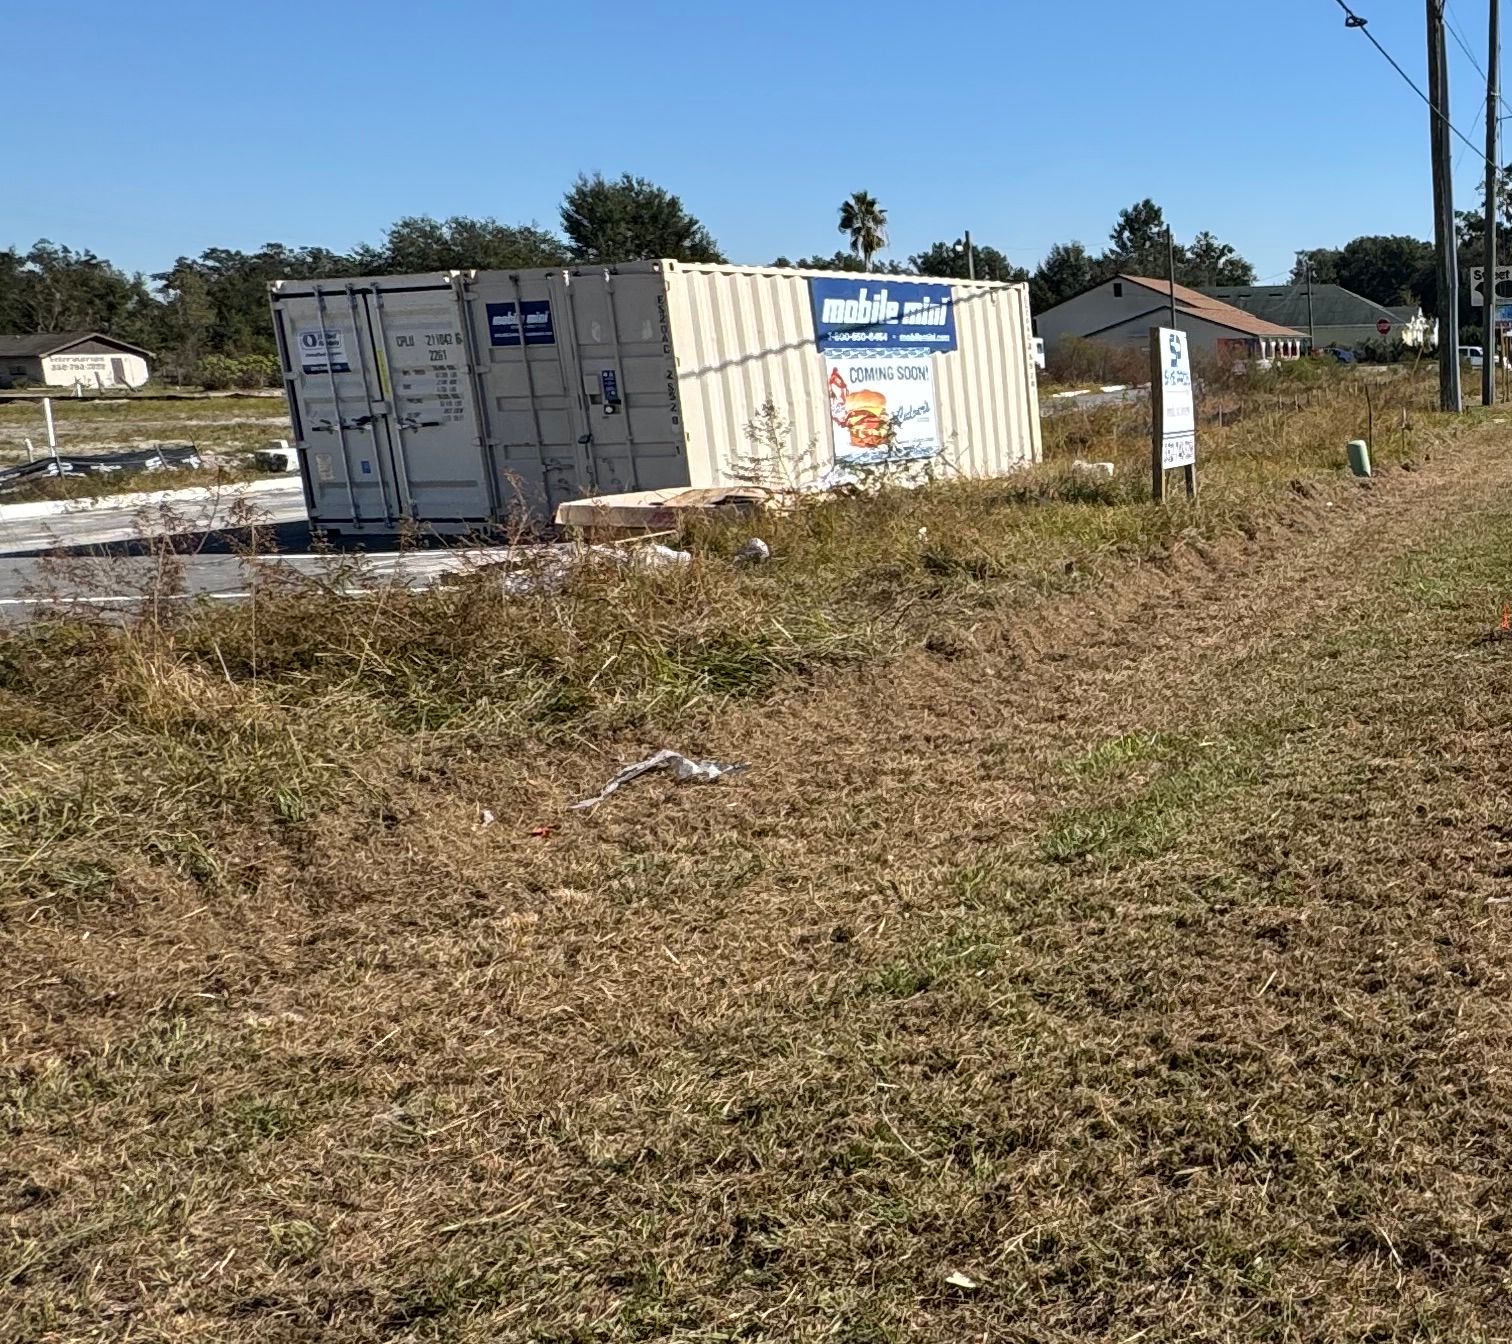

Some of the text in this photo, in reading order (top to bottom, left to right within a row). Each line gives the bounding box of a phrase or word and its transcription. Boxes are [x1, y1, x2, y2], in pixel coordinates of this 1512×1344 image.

[822, 288, 948, 325] mobile mini
[849, 365, 929, 384] COMING SOON!
